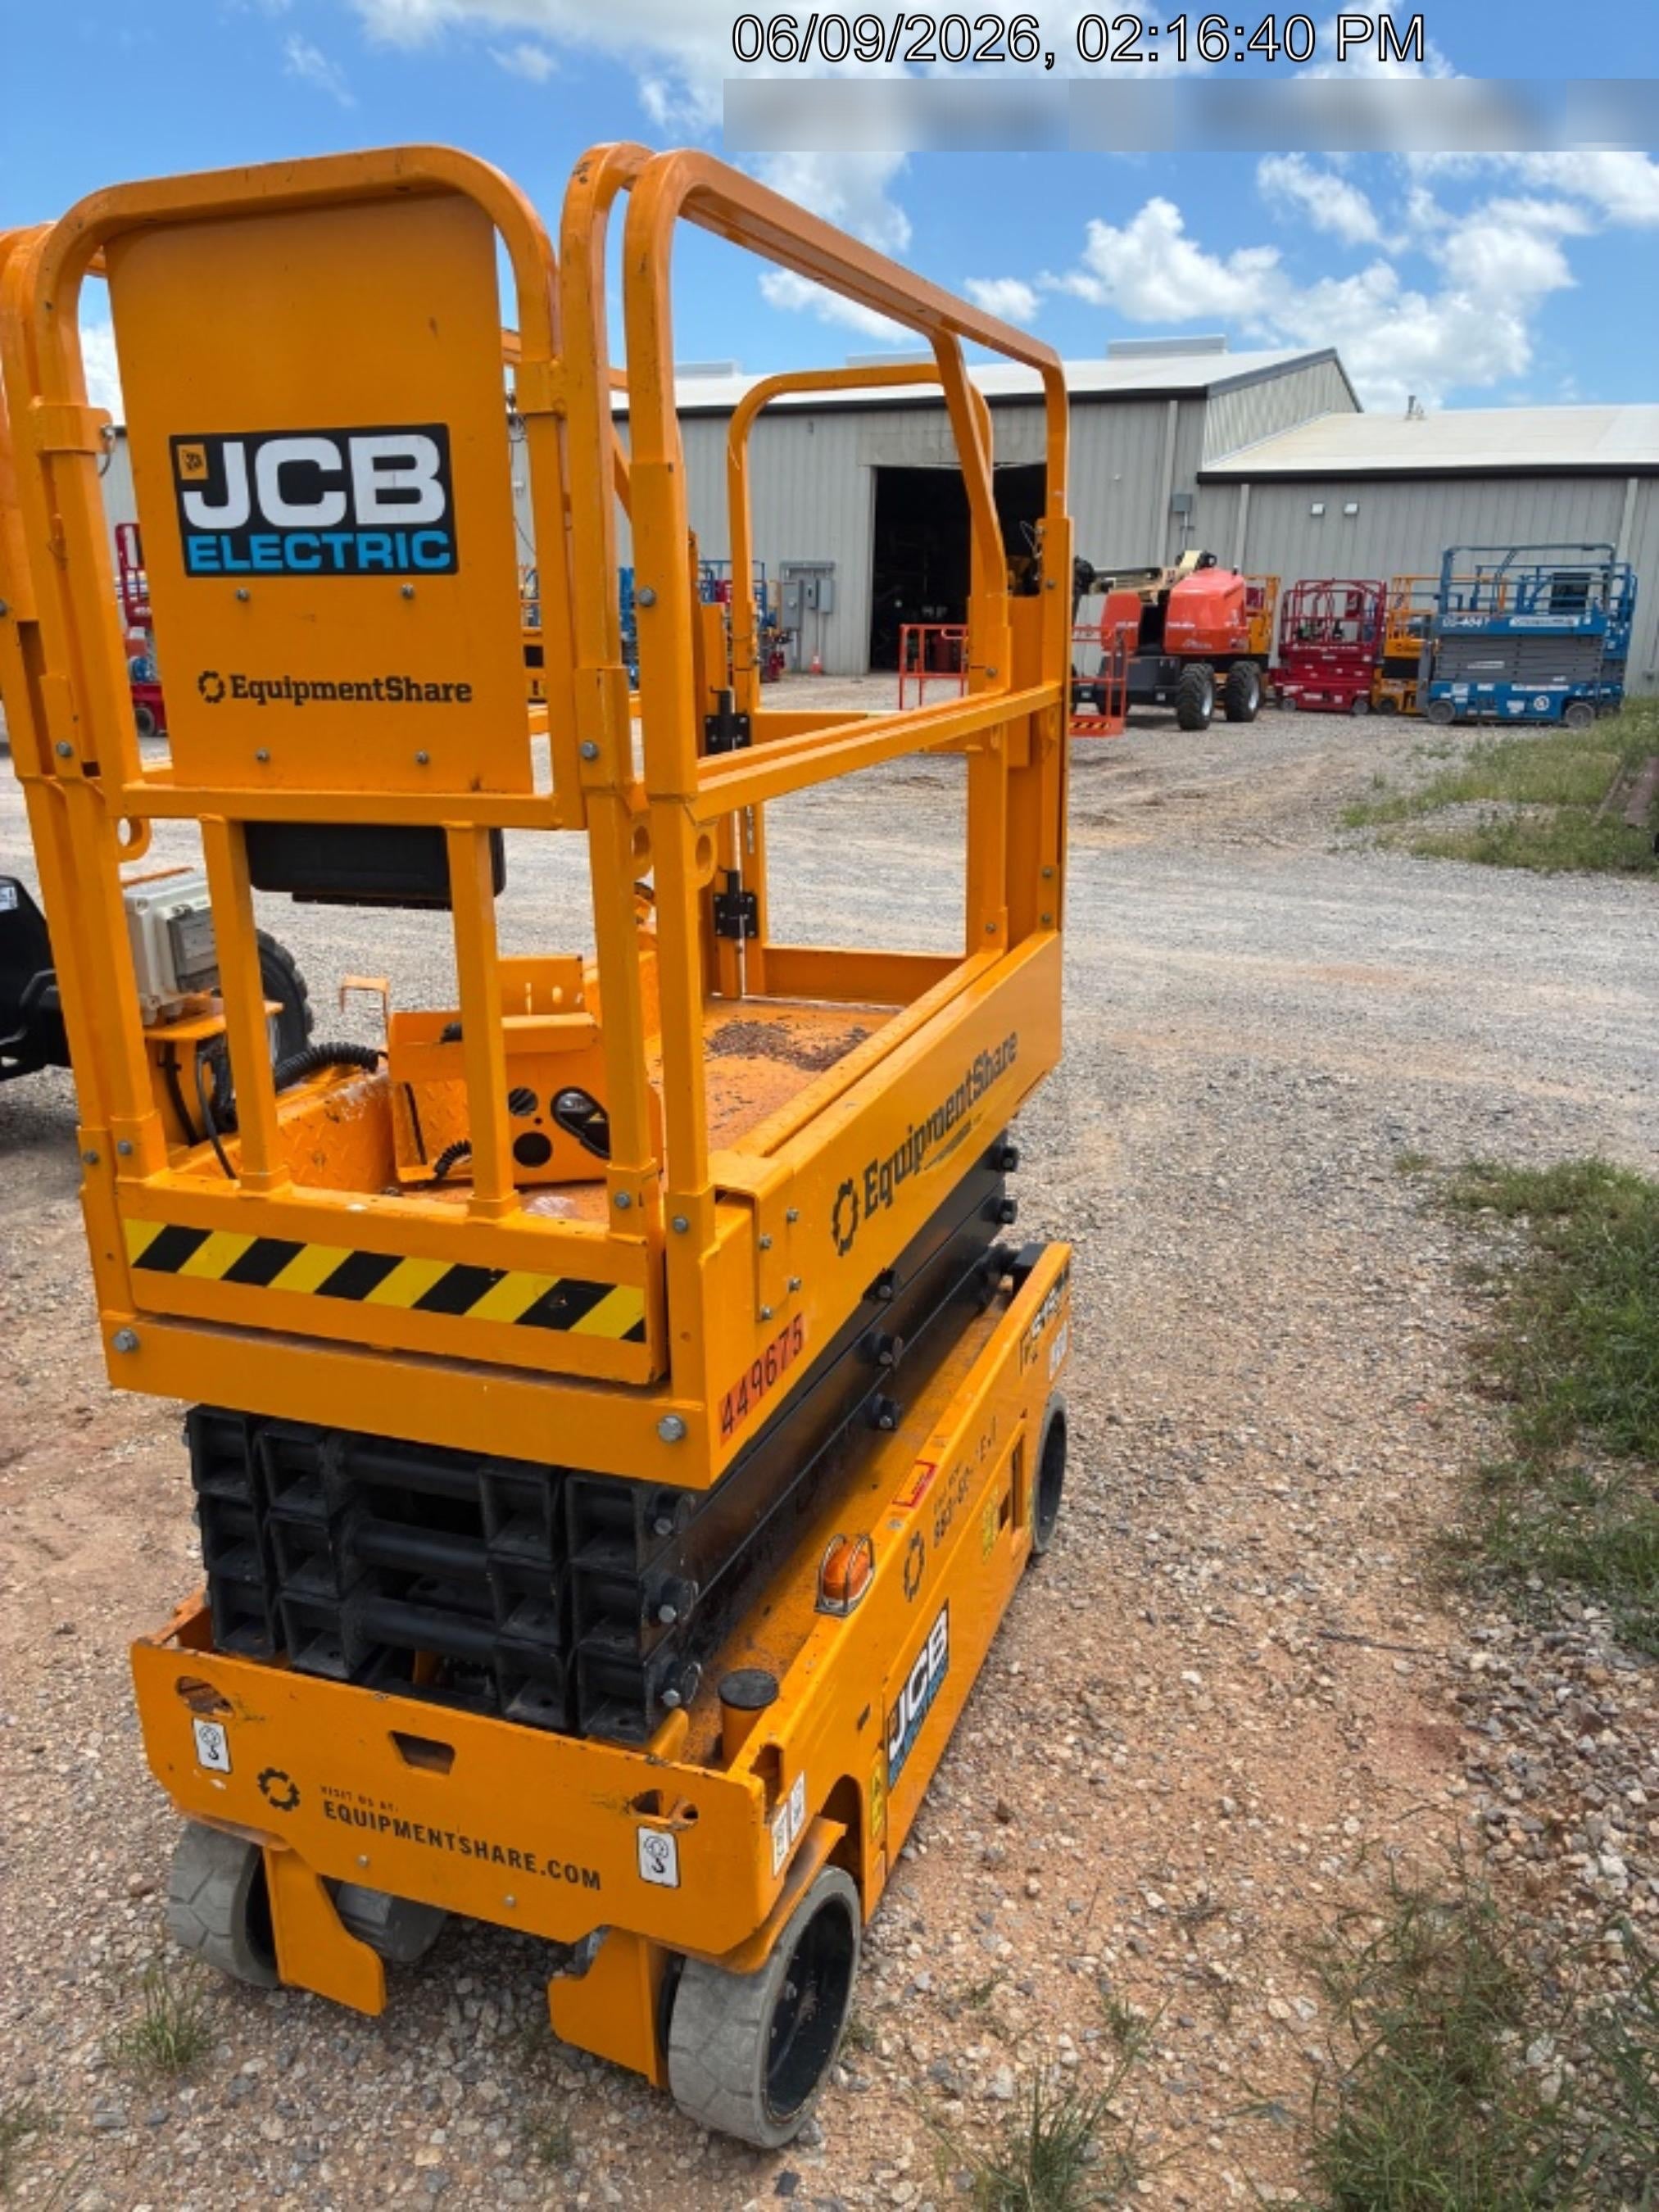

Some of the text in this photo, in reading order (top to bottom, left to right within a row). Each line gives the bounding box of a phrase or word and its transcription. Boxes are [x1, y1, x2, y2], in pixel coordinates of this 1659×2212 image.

[183, 434, 446, 530] JCB
[187, 530, 451, 572] ELECTRIC
[229, 674, 473, 706] EquipmentShare
[863, 1031, 1018, 1220] EquipmentShare
[722, 1312, 802, 1435] 449675
[888, 1608, 948, 1762] JCB
[323, 1799, 601, 1891] EQUIPMENTSHARE.COM
